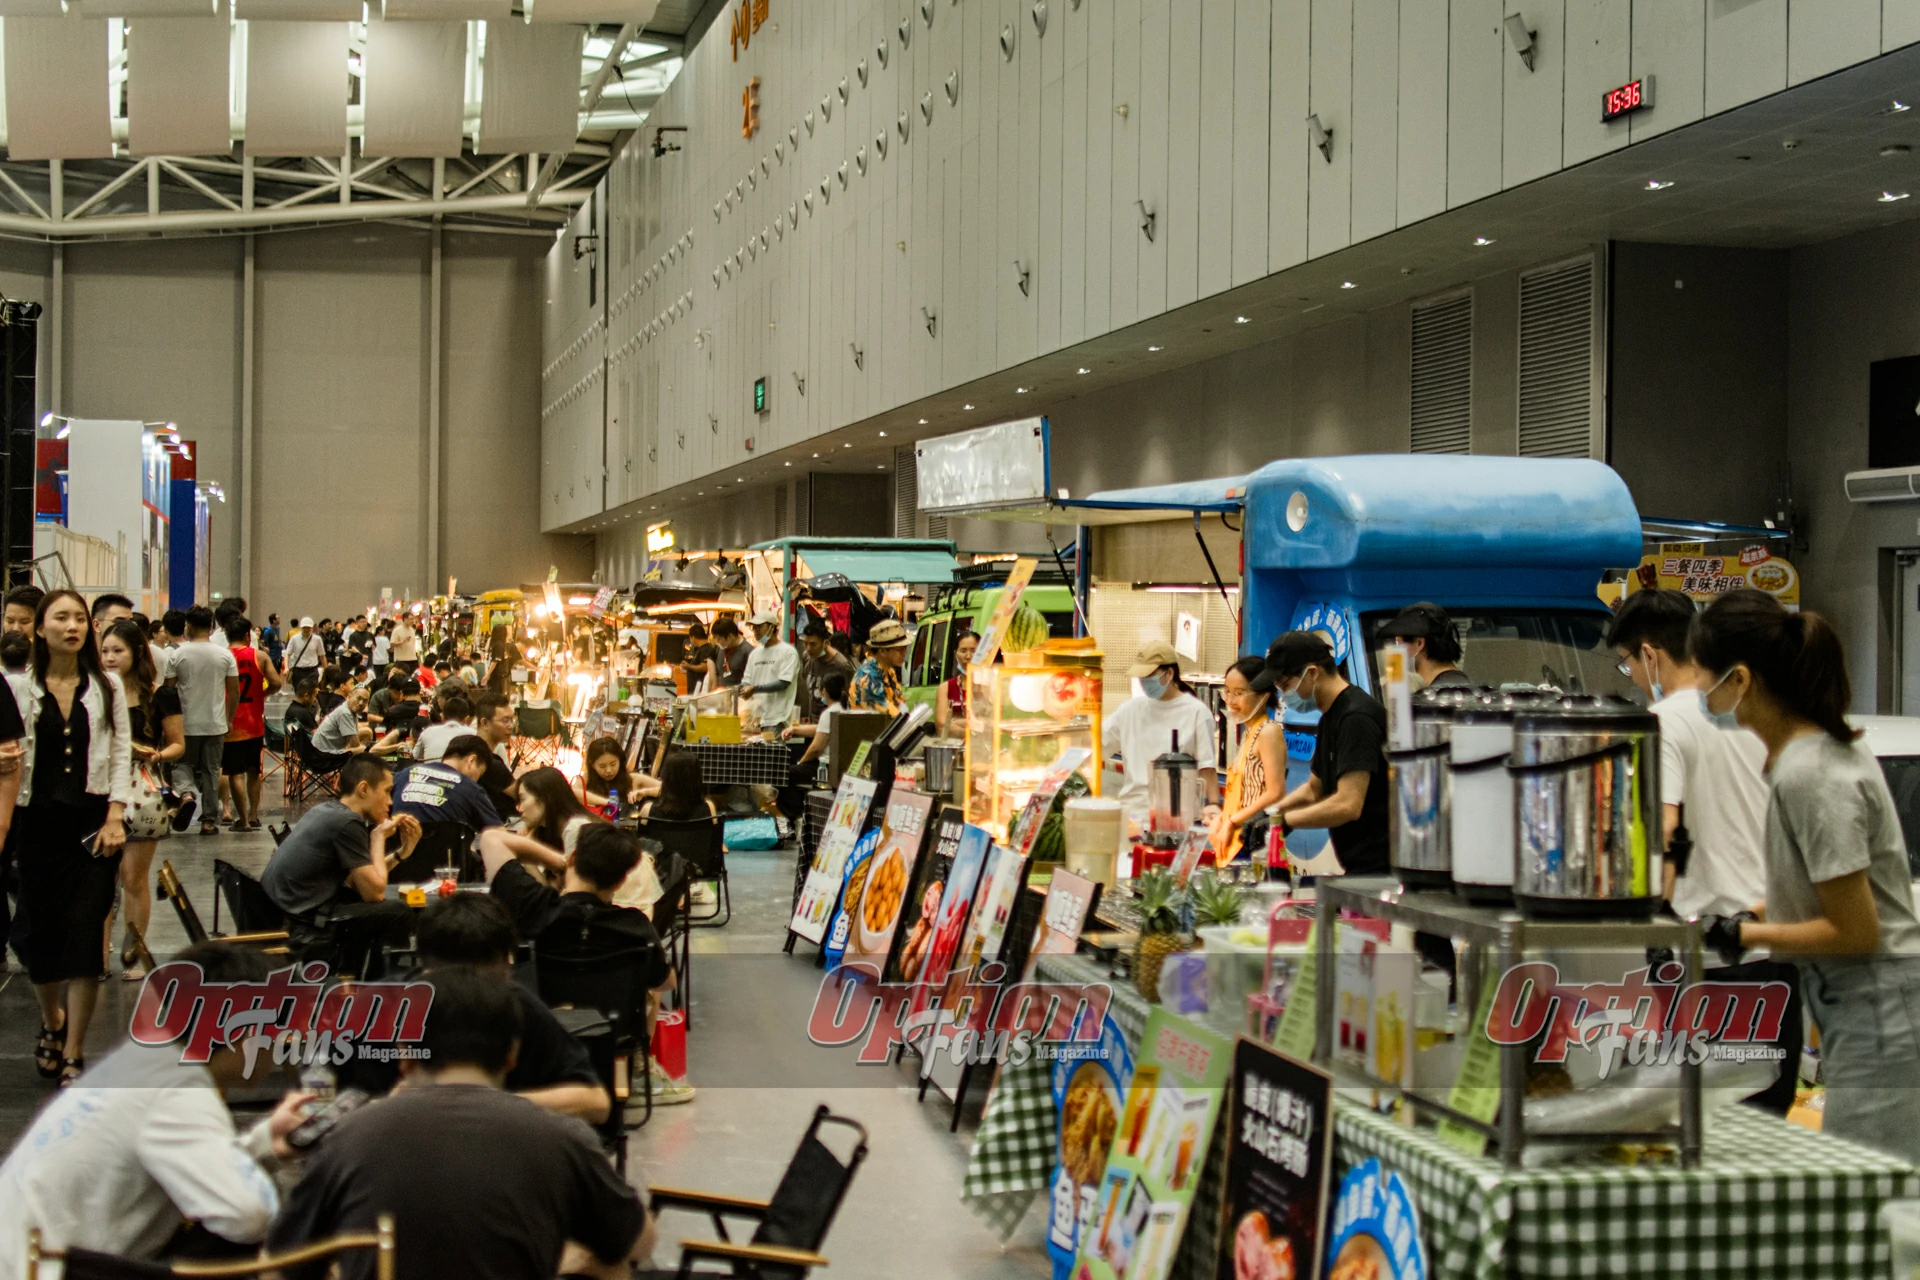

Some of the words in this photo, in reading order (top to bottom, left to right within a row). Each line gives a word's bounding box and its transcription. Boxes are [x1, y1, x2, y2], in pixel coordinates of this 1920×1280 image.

[1607, 81, 1641, 114] 15:36
[1661, 558, 1723, 575] 三餐四季
[1682, 576, 1744, 593] 美味相伴
[140, 815, 157, 825] bear
